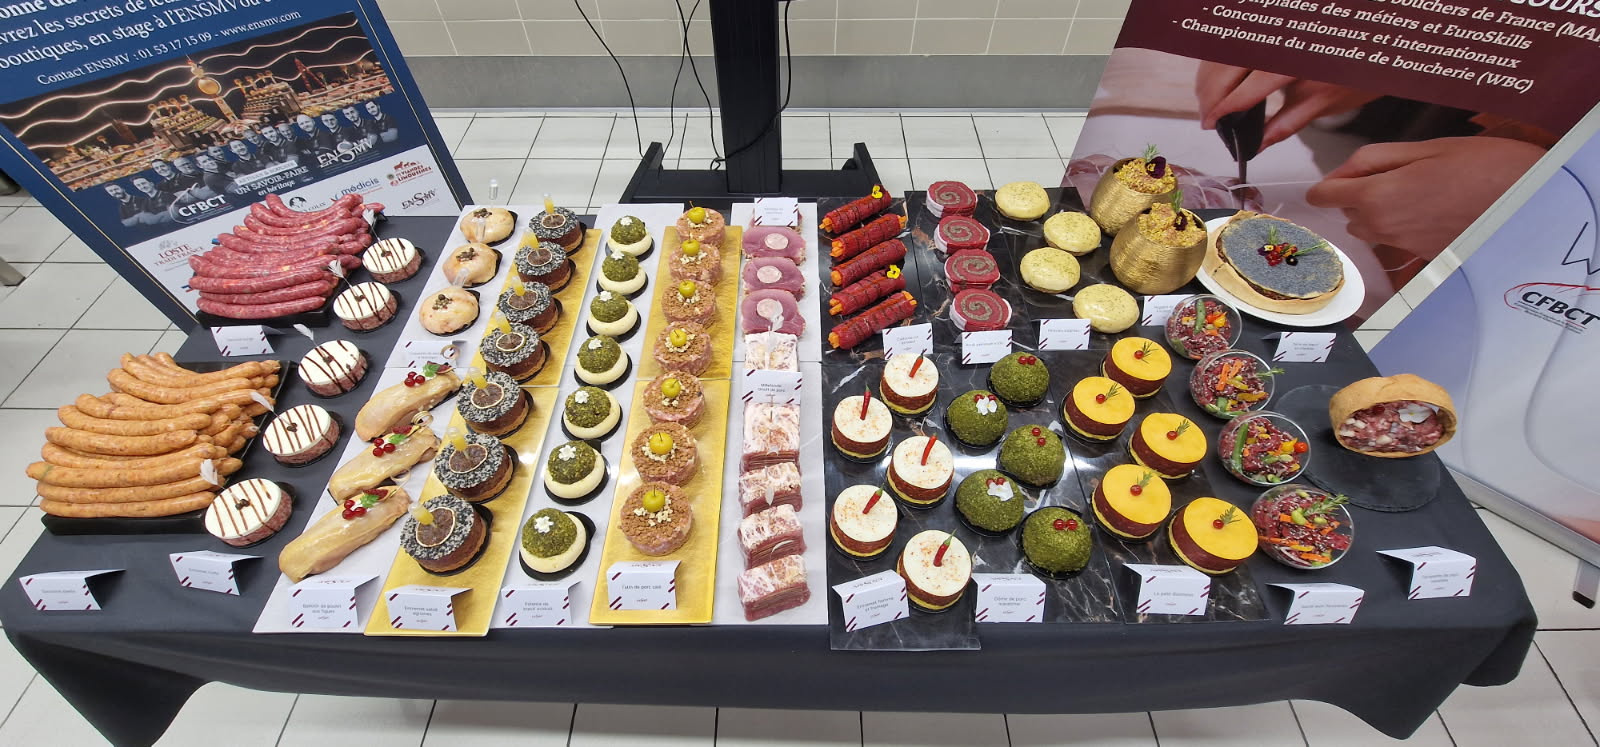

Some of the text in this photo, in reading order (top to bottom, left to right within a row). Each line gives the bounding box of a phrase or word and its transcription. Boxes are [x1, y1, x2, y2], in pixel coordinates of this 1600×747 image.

[33, 20, 65, 34] les
[65, 5, 124, 28] secrets
[88, 32, 113, 46] en
[112, 20, 155, 39] stage
[153, 14, 168, 29] à
[1321, 2, 1352, 18] des
[1354, 10, 1420, 30] métiers
[1422, 22, 1443, 34] et
[1442, 24, 1533, 50] EuroSkills
[1472, 7, 1494, 20] de
[1496, 11, 1556, 32] France
[36, 67, 86, 86] Contact
[84, 52, 130, 74] ENSMV
[154, 43, 168, 55] 53
[169, 39, 182, 50] 17
[183, 35, 198, 46] 15
[198, 31, 212, 43] 09
[220, 9, 302, 38] www.ensmv.com
[1212, 5, 1284, 26] Concours
[1286, 20, 1370, 40] nationaux
[1372, 34, 1392, 45] et
[1391, 35, 1522, 69] internationaux
[1182, 18, 1283, 46] Championnat
[1284, 36, 1306, 50] du
[1308, 42, 1366, 60] monde
[1368, 51, 1390, 66] de
[1392, 54, 1476, 82] boucherie
[1476, 71, 1536, 94] (WBC)
[235, 166, 309, 195] UN SAVOIR-FAIRE
[267, 180, 296, 193] héritage
[341, 176, 380, 195] médicis
[178, 194, 227, 218] CFBCT
[158, 244, 191, 259] LOSTE
[1522, 291, 1600, 326] CFBCT
